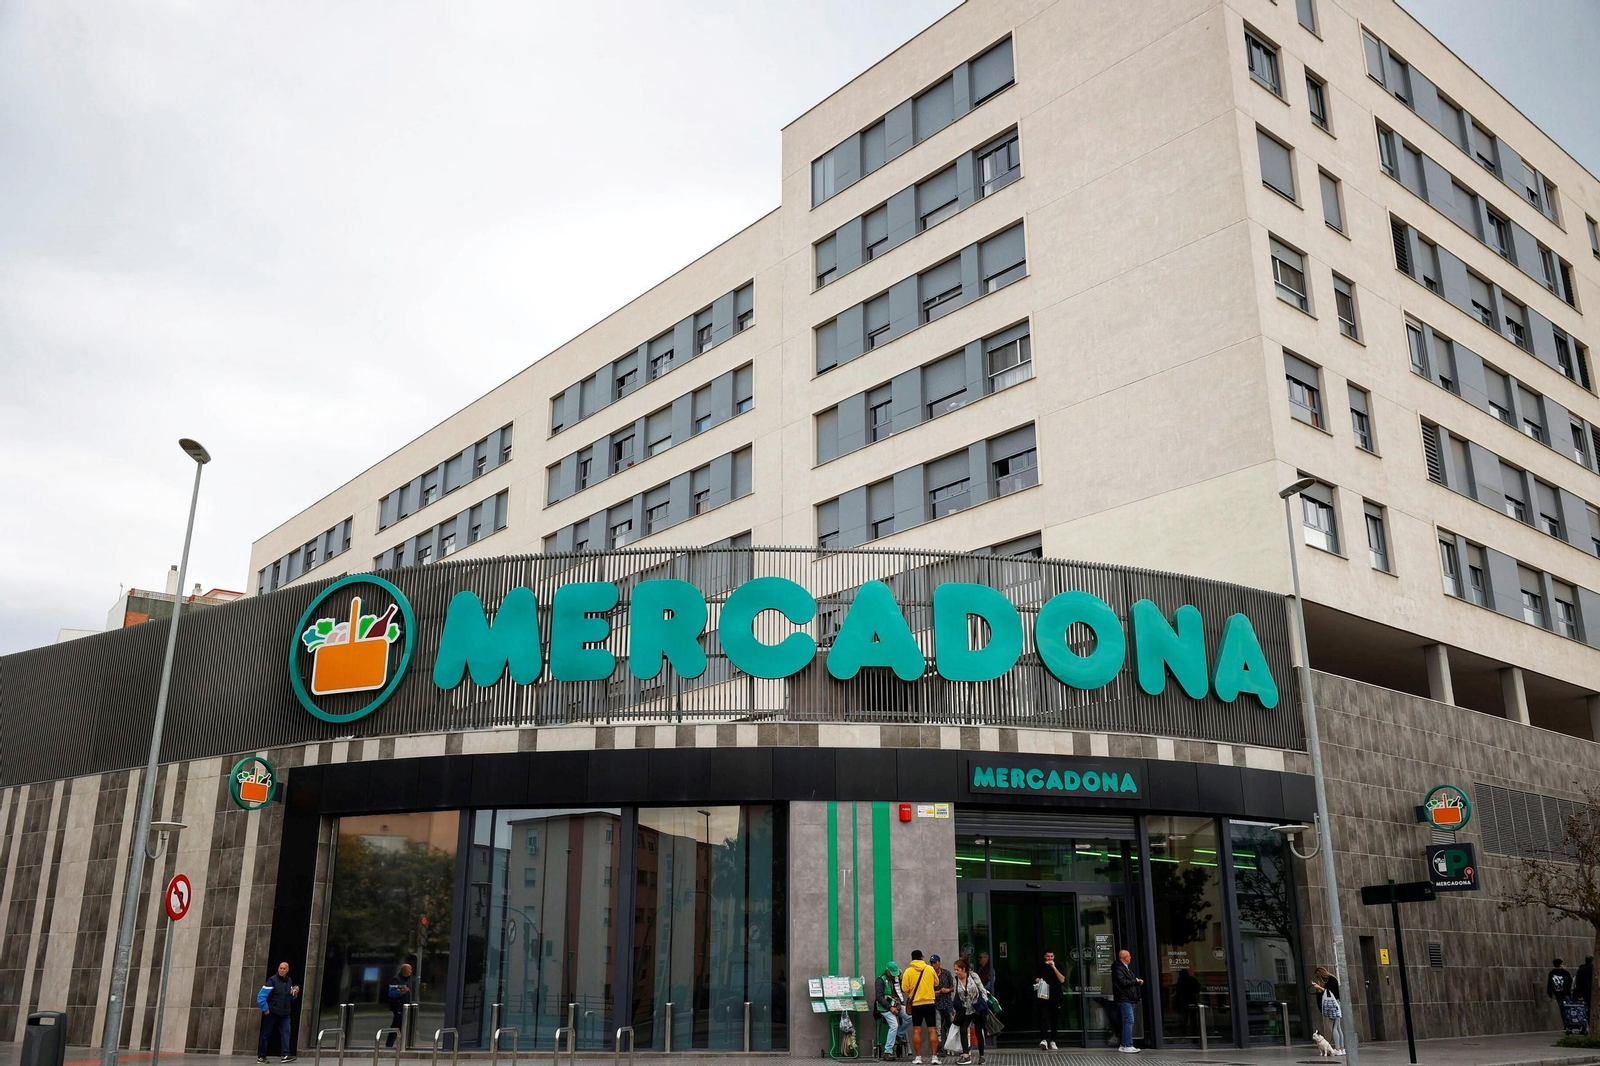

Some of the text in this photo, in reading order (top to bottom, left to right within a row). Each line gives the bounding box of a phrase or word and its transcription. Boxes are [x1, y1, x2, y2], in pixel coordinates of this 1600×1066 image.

[433, 577, 1279, 709] MERCADONA
[973, 766, 1138, 793] MERCADONA
[1444, 849, 1468, 877] P
